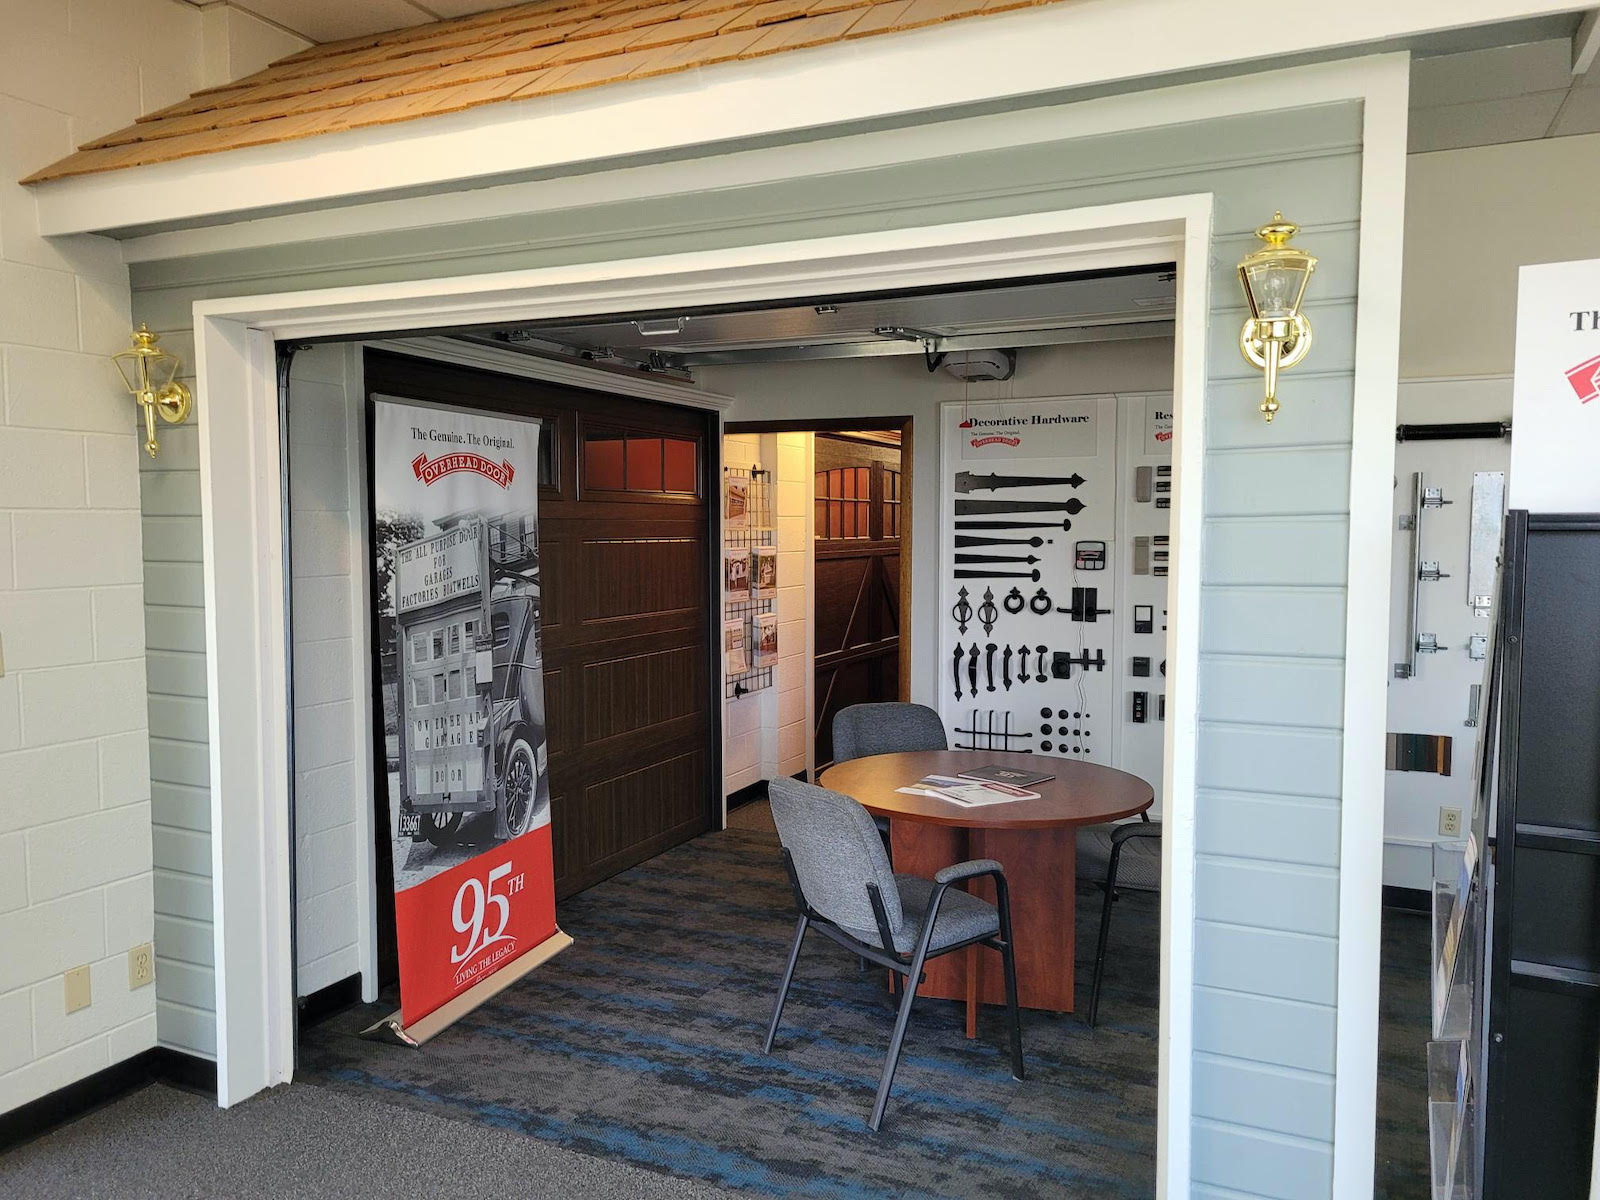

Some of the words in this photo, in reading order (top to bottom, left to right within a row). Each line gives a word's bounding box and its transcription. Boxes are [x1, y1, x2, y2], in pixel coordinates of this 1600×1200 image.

[969, 415, 1028, 428] Decorative
[1031, 414, 1090, 425] Hardware
[410, 427, 428, 440] The
[429, 429, 466, 444] Genuine.
[467, 432, 481, 446] The
[482, 434, 515, 450] Original.
[425, 456, 479, 480] OVERHEAD
[480, 461, 506, 485] DOOR
[401, 549, 413, 565] THE
[415, 545, 427, 559] ALL
[430, 532, 457, 554] PURPOSE
[433, 554, 446, 569] FOR
[424, 566, 452, 587] GARAGES
[402, 587, 439, 608] FACTORIES
[455, 964, 478, 985] LIVING
[479, 954, 493, 973] THE
[491, 940, 516, 962] LEGACY
